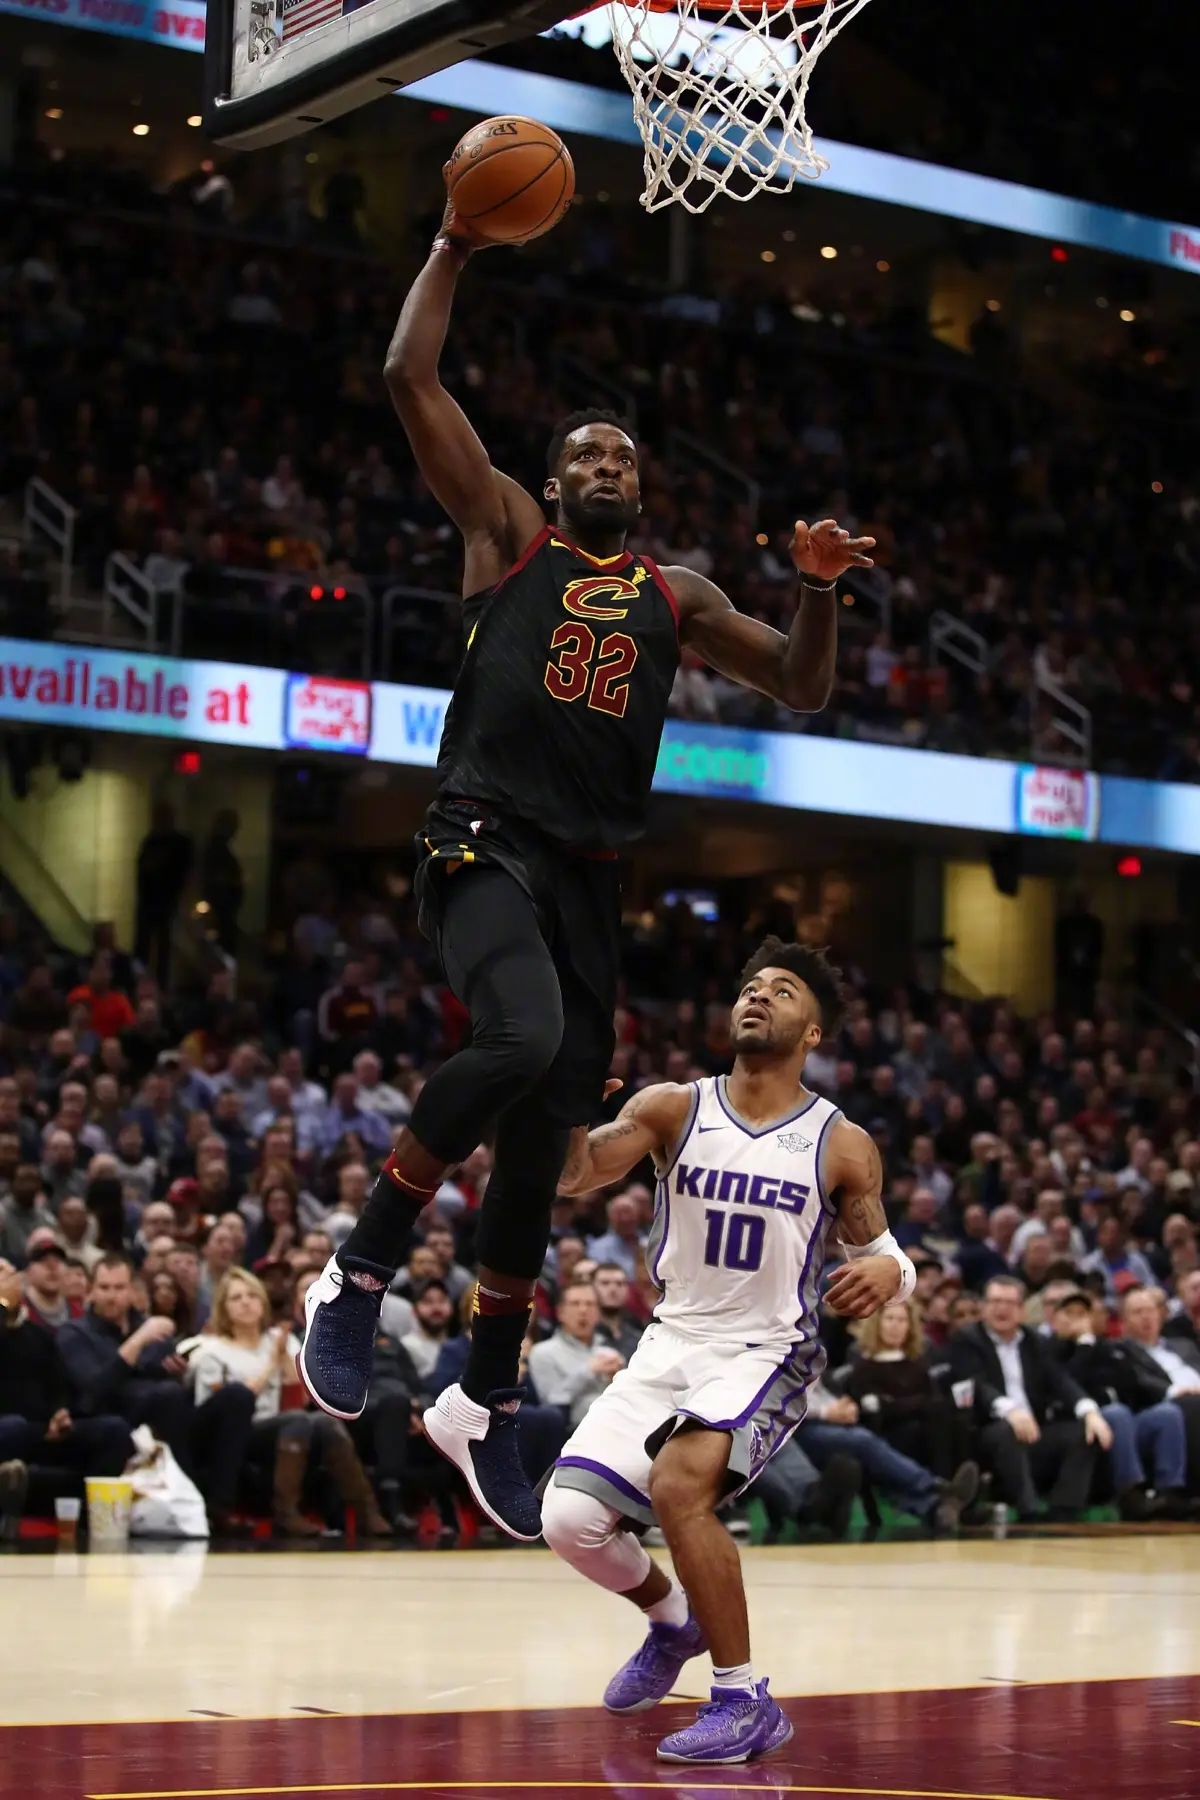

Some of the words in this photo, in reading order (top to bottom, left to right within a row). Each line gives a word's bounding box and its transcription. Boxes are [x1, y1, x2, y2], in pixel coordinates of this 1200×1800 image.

[544, 620, 638, 718] 32
[206, 682, 250, 726] at
[676, 1164, 811, 1216] KINGS
[704, 1208, 766, 1272] 10
